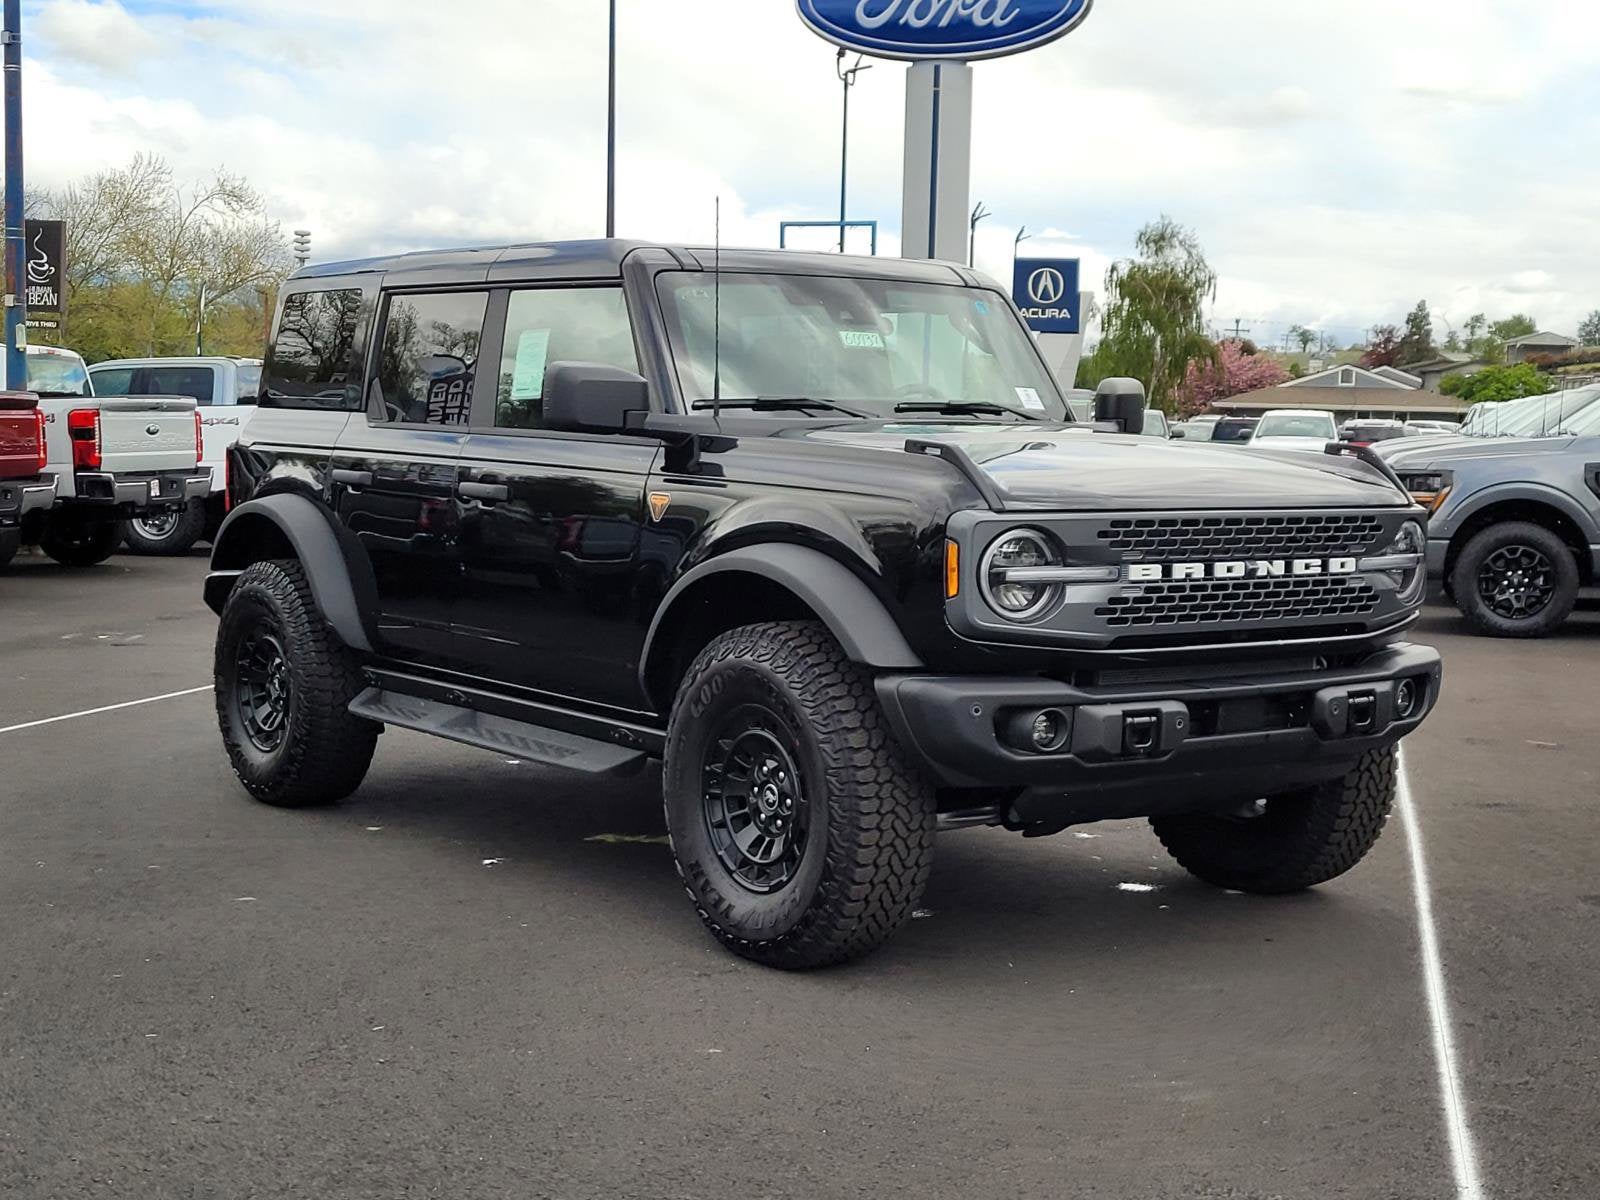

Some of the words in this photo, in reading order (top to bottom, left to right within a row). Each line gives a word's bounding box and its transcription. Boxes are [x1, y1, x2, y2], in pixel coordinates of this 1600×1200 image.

[28, 292, 58, 306] BEAN
[1020, 307, 1071, 319] ACURA
[1128, 557, 1356, 581] BRONCO
